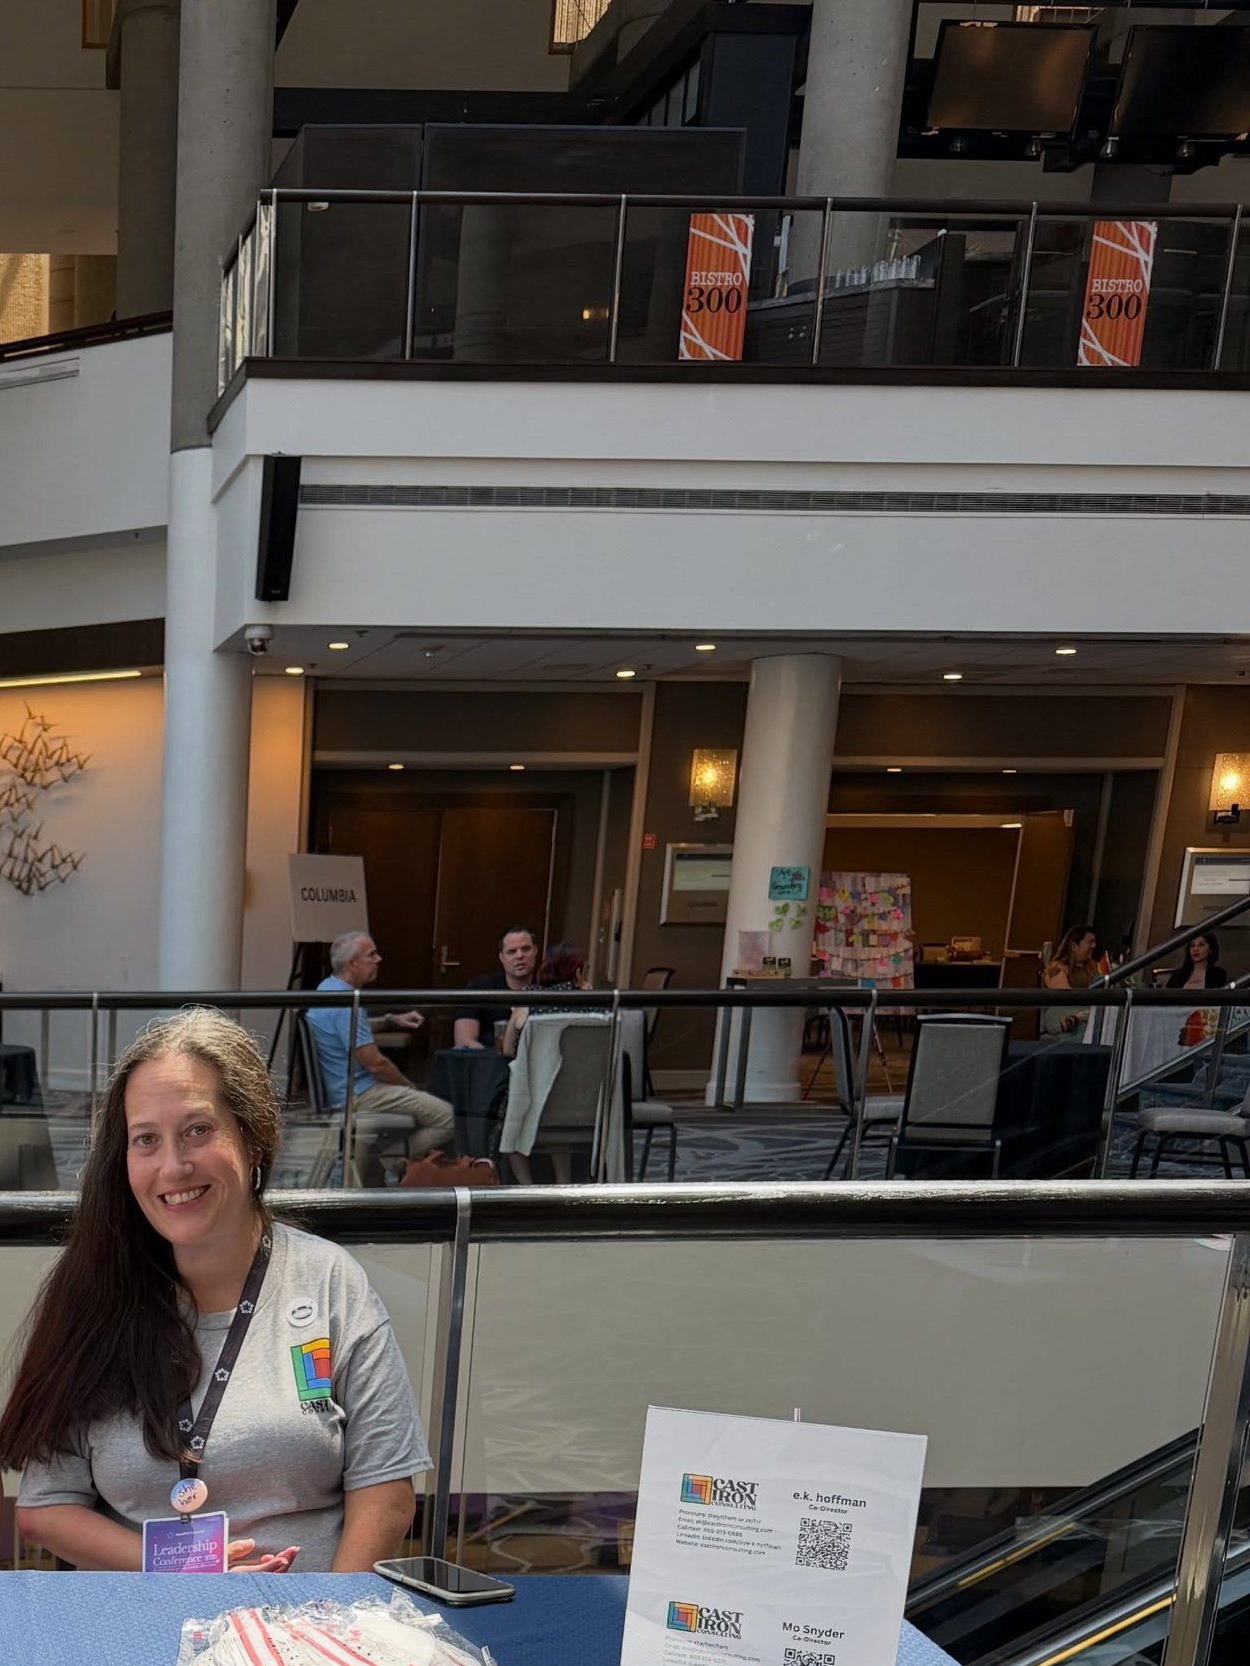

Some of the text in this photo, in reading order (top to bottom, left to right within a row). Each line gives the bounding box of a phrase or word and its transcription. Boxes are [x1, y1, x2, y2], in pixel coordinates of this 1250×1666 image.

[690, 271, 743, 286] BISTRO
[1091, 278, 1143, 293] BISTRO
[686, 287, 742, 314] 300
[1086, 294, 1142, 320] 300
[300, 887, 357, 904] COLUMBIA
[713, 1478, 760, 1495] CAST
[712, 1489, 758, 1506] IRON
[793, 1491, 867, 1508] e.k. hoffman
[808, 1504, 848, 1514] Co-Director
[152, 1538, 218, 1558] Leadership
[152, 1555, 203, 1568] Conference
[698, 1607, 744, 1624] CAST
[696, 1629, 741, 1640] CONSULTING
[697, 1617, 742, 1635] IRON
[782, 1622, 845, 1640] Mo Snyder
[792, 1635, 832, 1646] Co-Director
